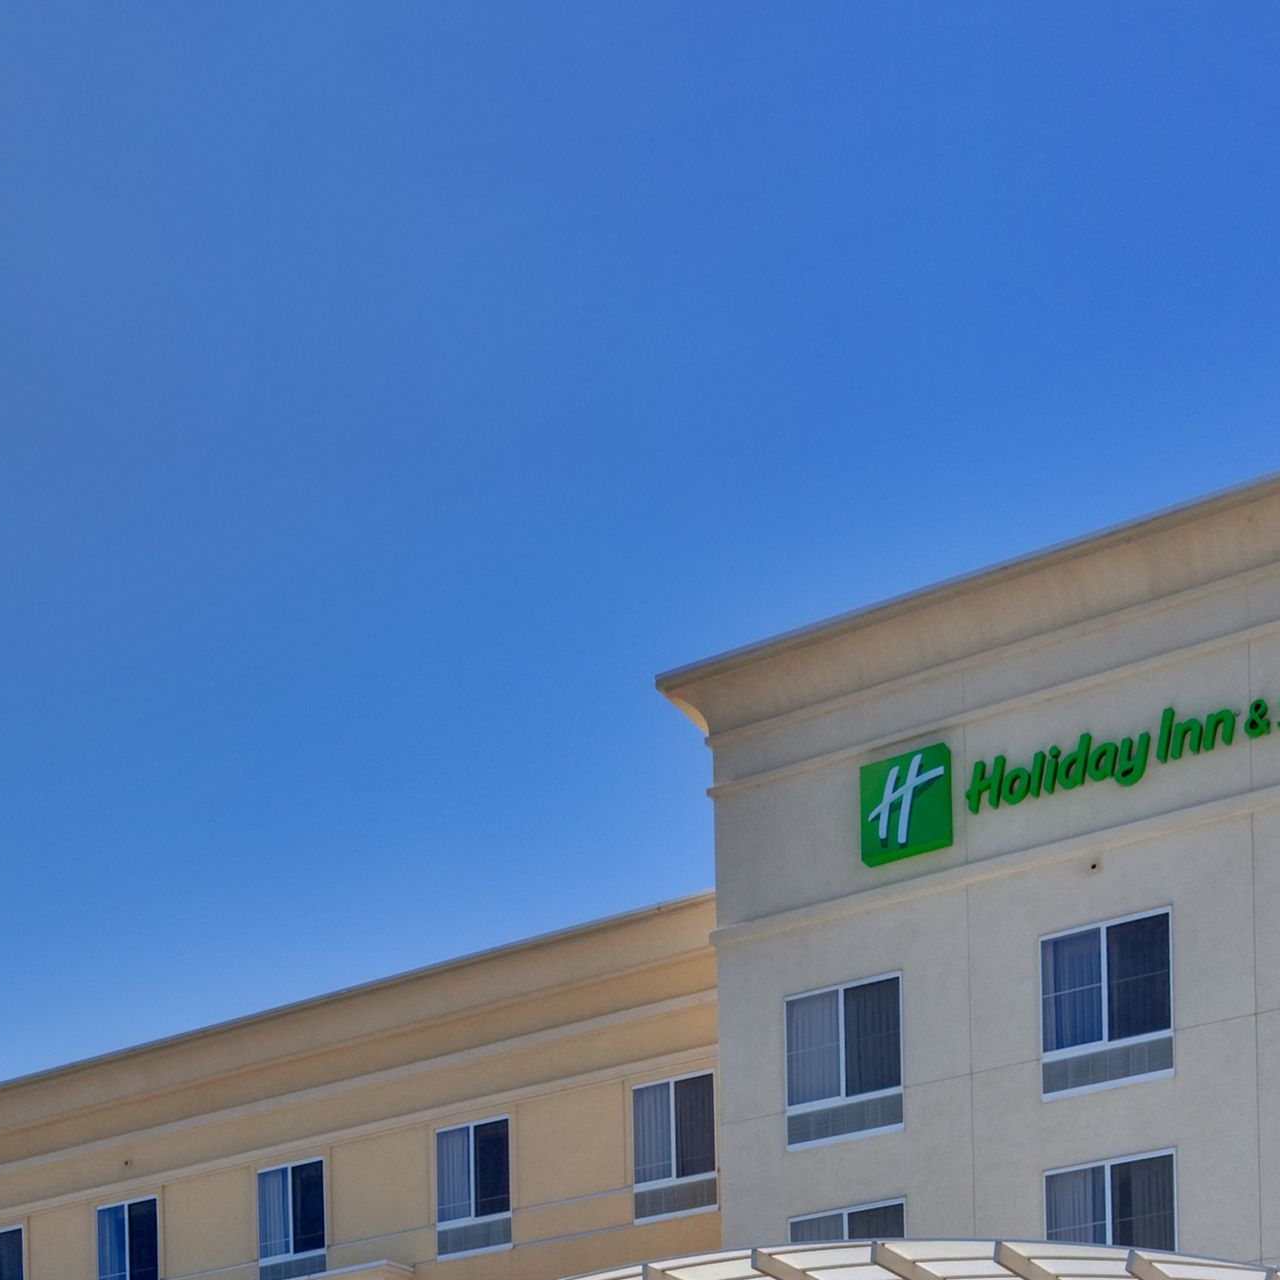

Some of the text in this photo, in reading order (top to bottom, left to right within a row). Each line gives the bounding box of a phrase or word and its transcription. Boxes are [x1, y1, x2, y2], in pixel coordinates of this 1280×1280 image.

[965, 732, 1151, 815] Holiday
[1156, 707, 1236, 764] Inn
[1244, 699, 1271, 739] &
